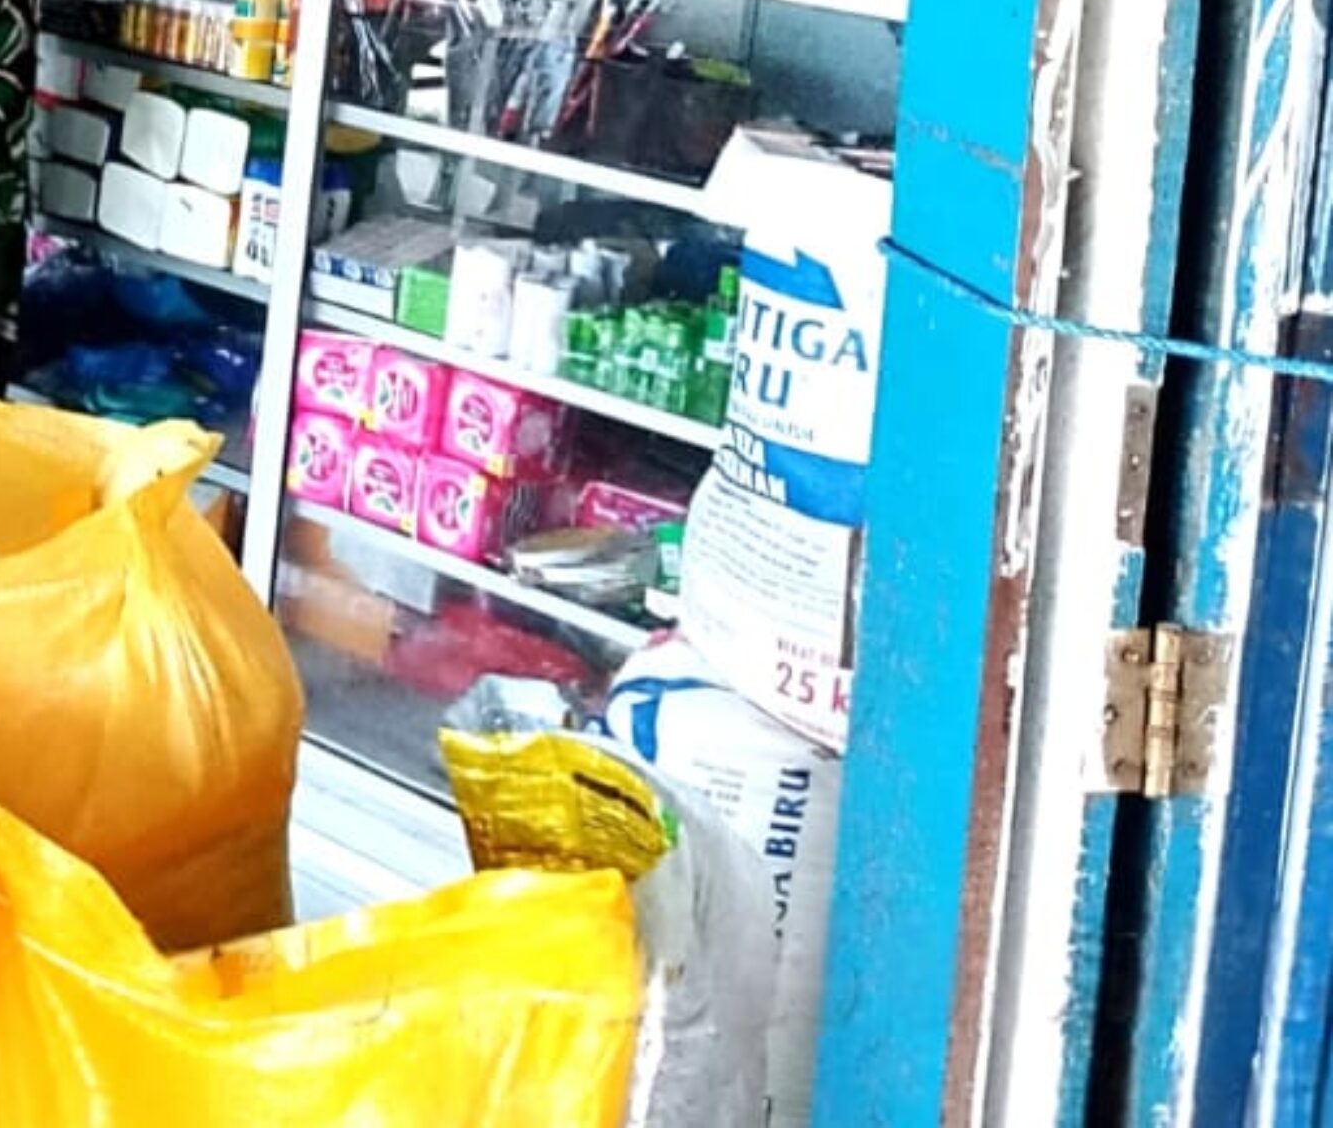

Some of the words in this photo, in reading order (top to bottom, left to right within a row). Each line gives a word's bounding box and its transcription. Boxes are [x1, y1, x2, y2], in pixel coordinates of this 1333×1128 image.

[738, 292, 869, 372] ITIGA
[733, 351, 793, 409] RU
[775, 661, 817, 705] 25
[831, 675, 849, 714] k
[765, 767, 812, 860] BIRU
